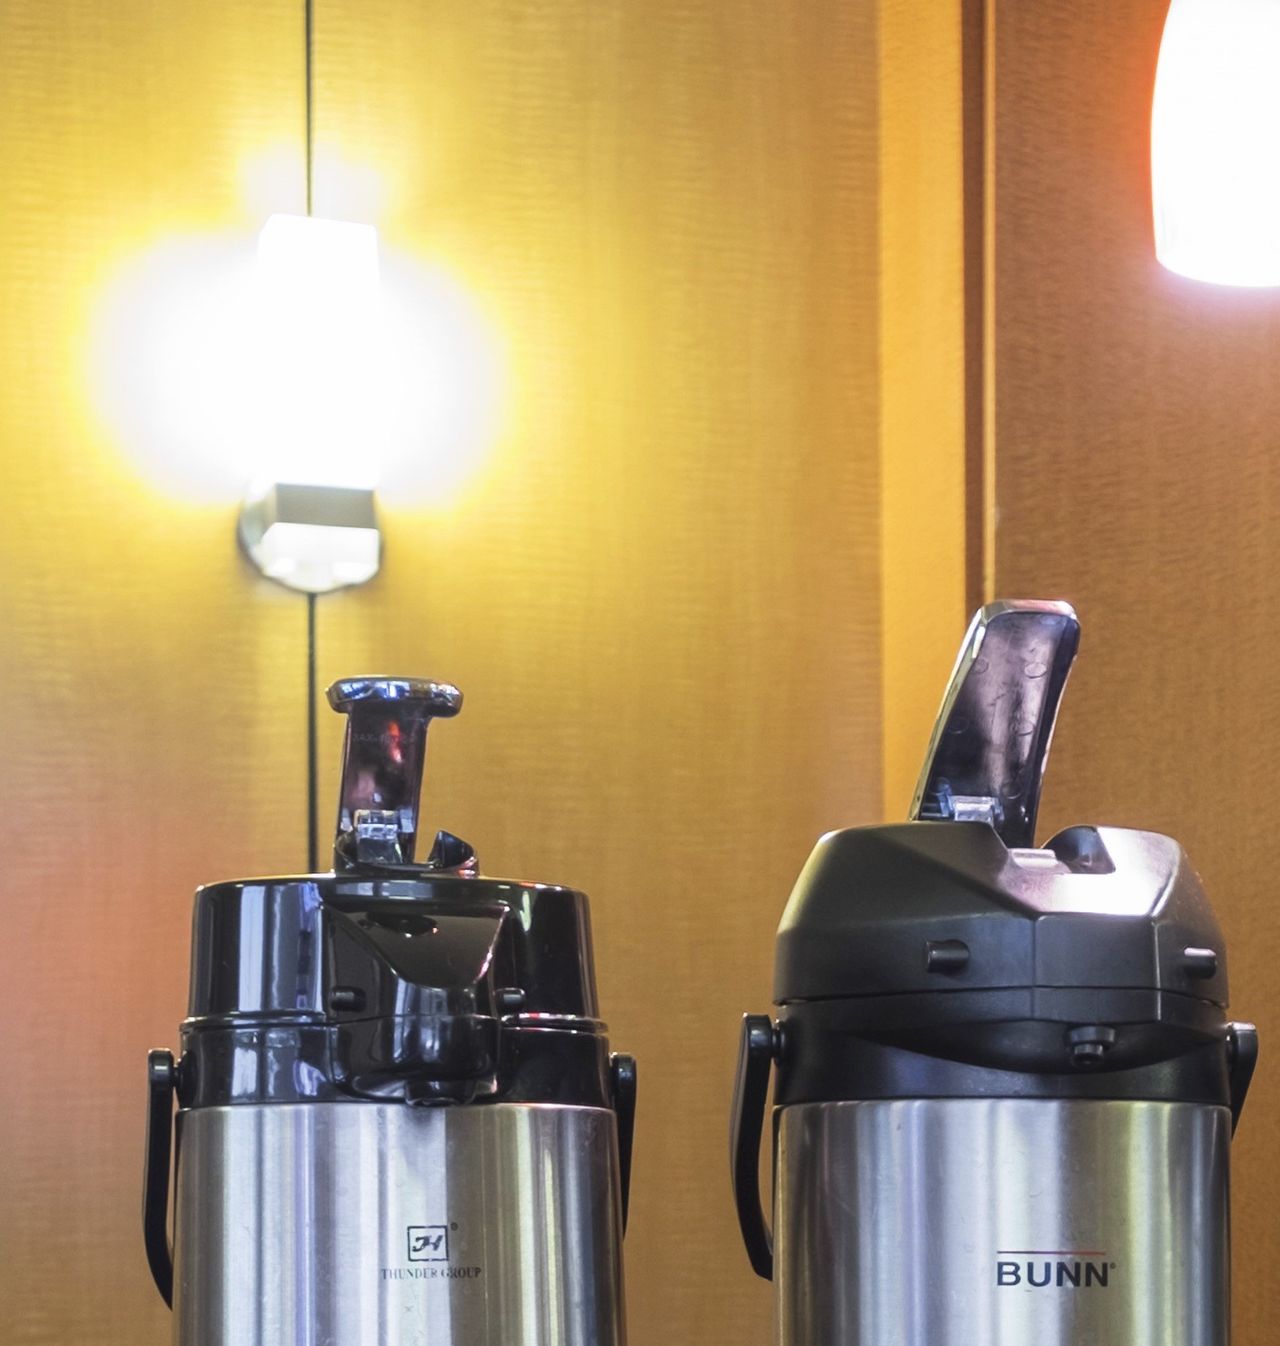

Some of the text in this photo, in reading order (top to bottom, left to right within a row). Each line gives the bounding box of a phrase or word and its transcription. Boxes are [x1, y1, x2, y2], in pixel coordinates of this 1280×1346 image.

[382, 1266, 482, 1280] THUNDER GROUP
[997, 1261, 1108, 1287] BUNN
